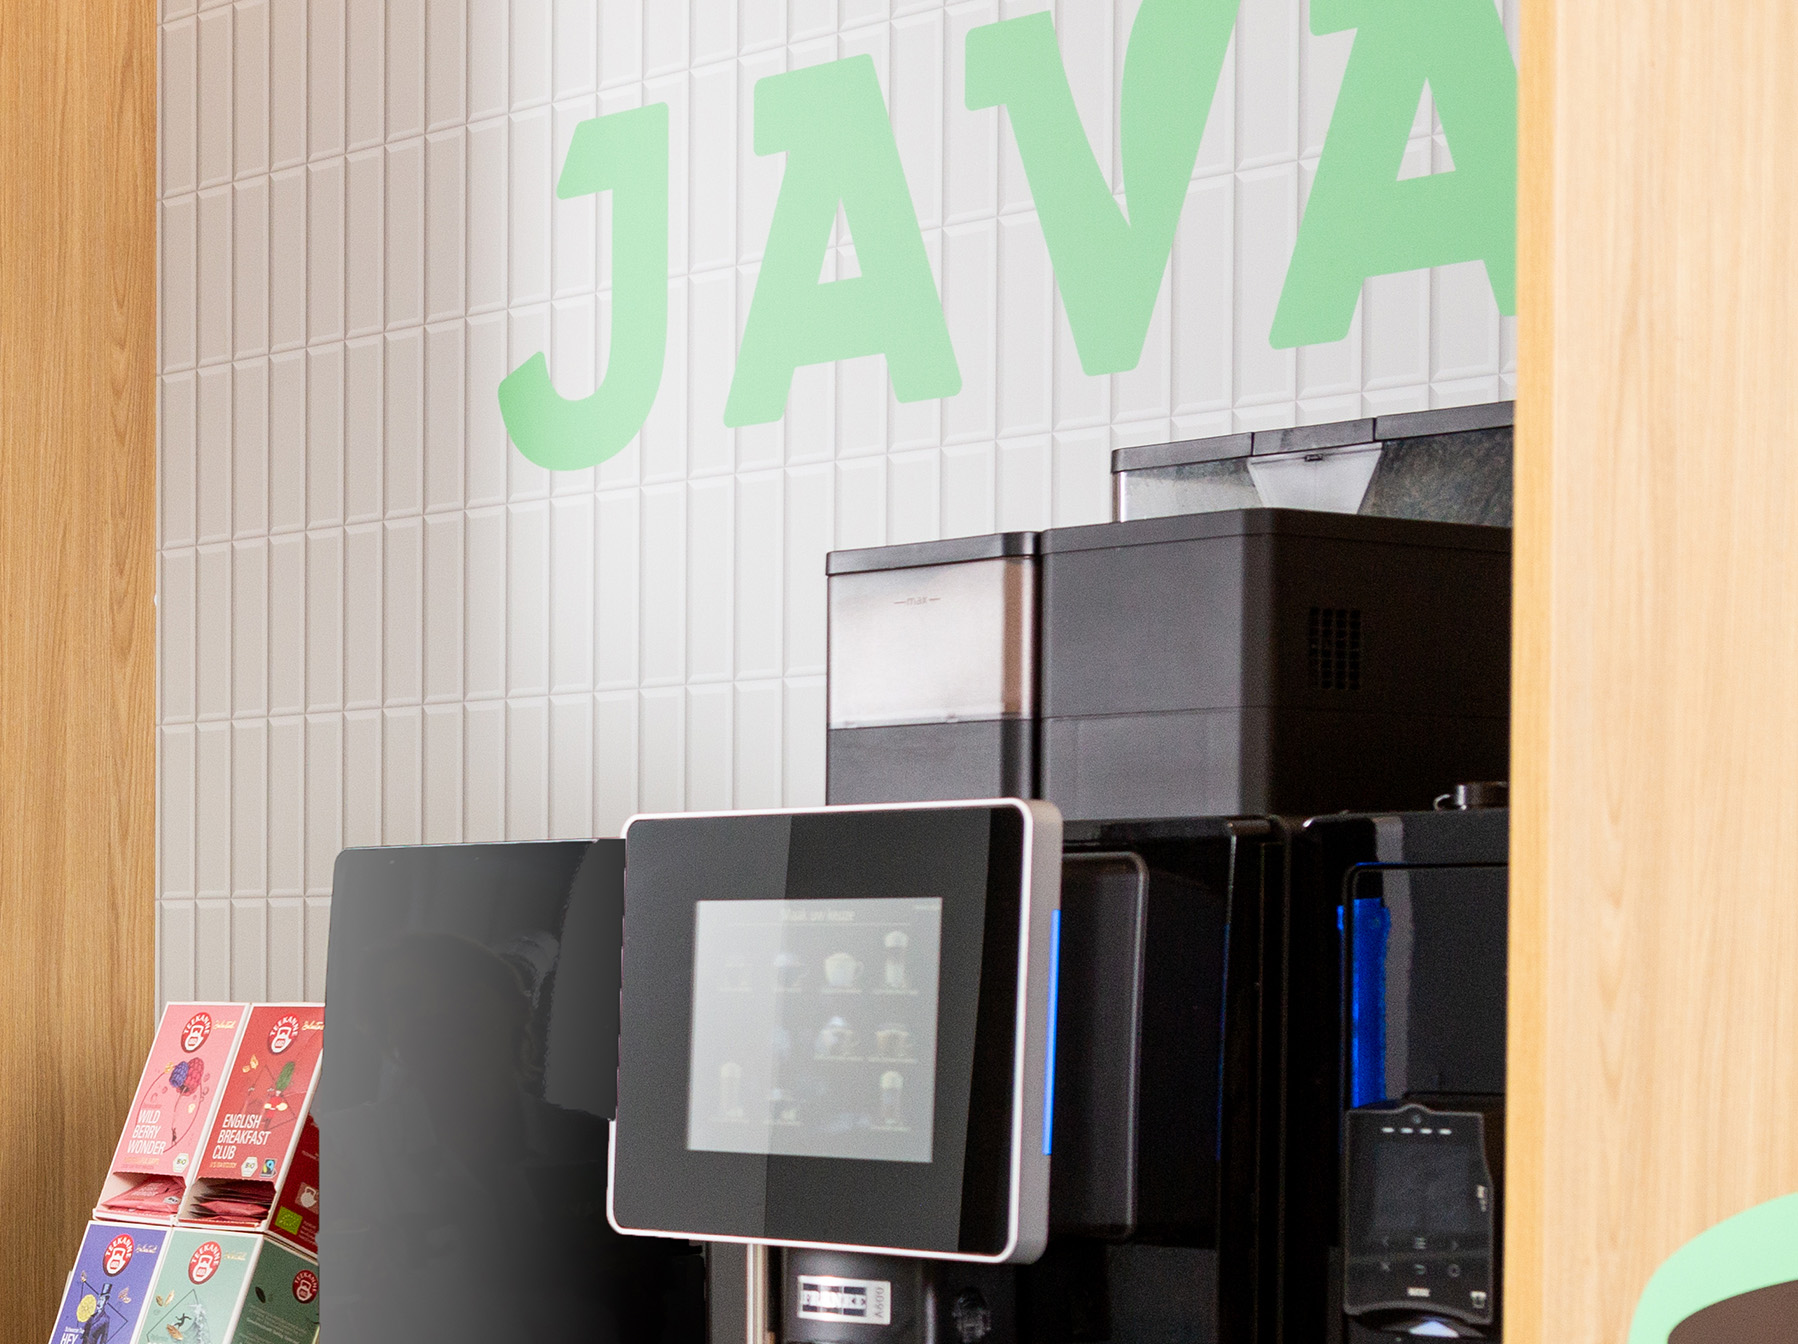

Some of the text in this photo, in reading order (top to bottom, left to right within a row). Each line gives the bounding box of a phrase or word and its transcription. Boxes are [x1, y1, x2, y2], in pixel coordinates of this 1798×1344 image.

[498, 0, 1516, 471] JAVA
[184, 1012, 210, 1035] TEEKANNE
[270, 1015, 299, 1037] TEEKANNE
[138, 1109, 161, 1124] WILD
[222, 1113, 262, 1129] ENGLISH
[132, 1124, 161, 1139] BERRY
[217, 1129, 271, 1145] BREAKFAST
[127, 1140, 166, 1155] WONDER
[212, 1145, 237, 1160] CLUB
[105, 1236, 132, 1258] TEEKANNE
[191, 1243, 219, 1266] TEEKANNE
